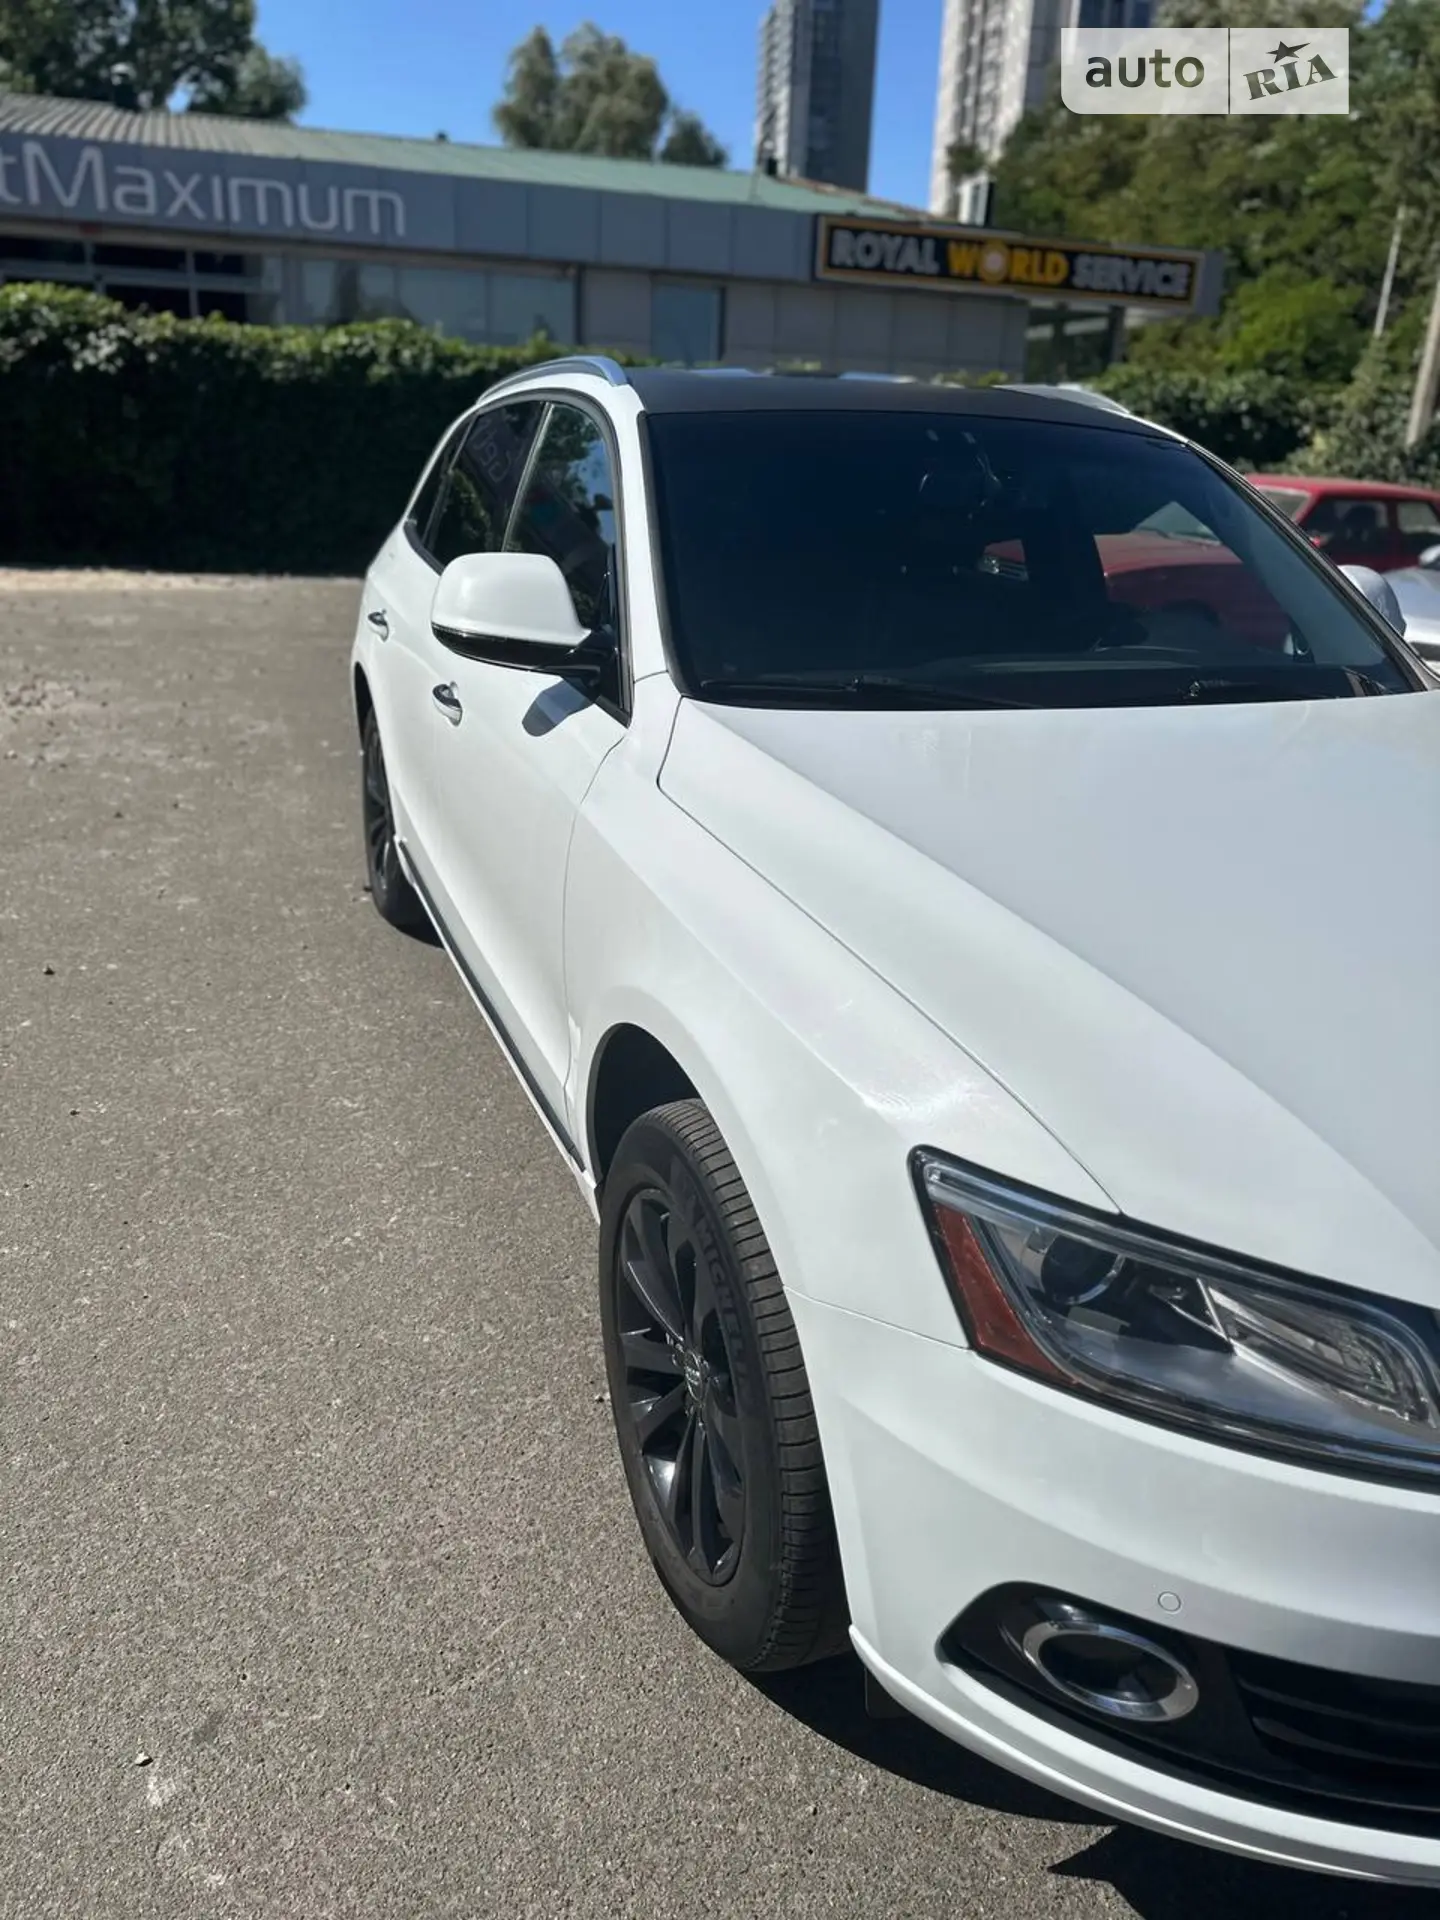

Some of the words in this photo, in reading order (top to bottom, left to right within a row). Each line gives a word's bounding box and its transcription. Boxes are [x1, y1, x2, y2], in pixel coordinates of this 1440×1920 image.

[831, 228, 941, 275] ROYAL
[948, 238, 1070, 286] WORLD
[1072, 253, 1191, 298] SERVICE
